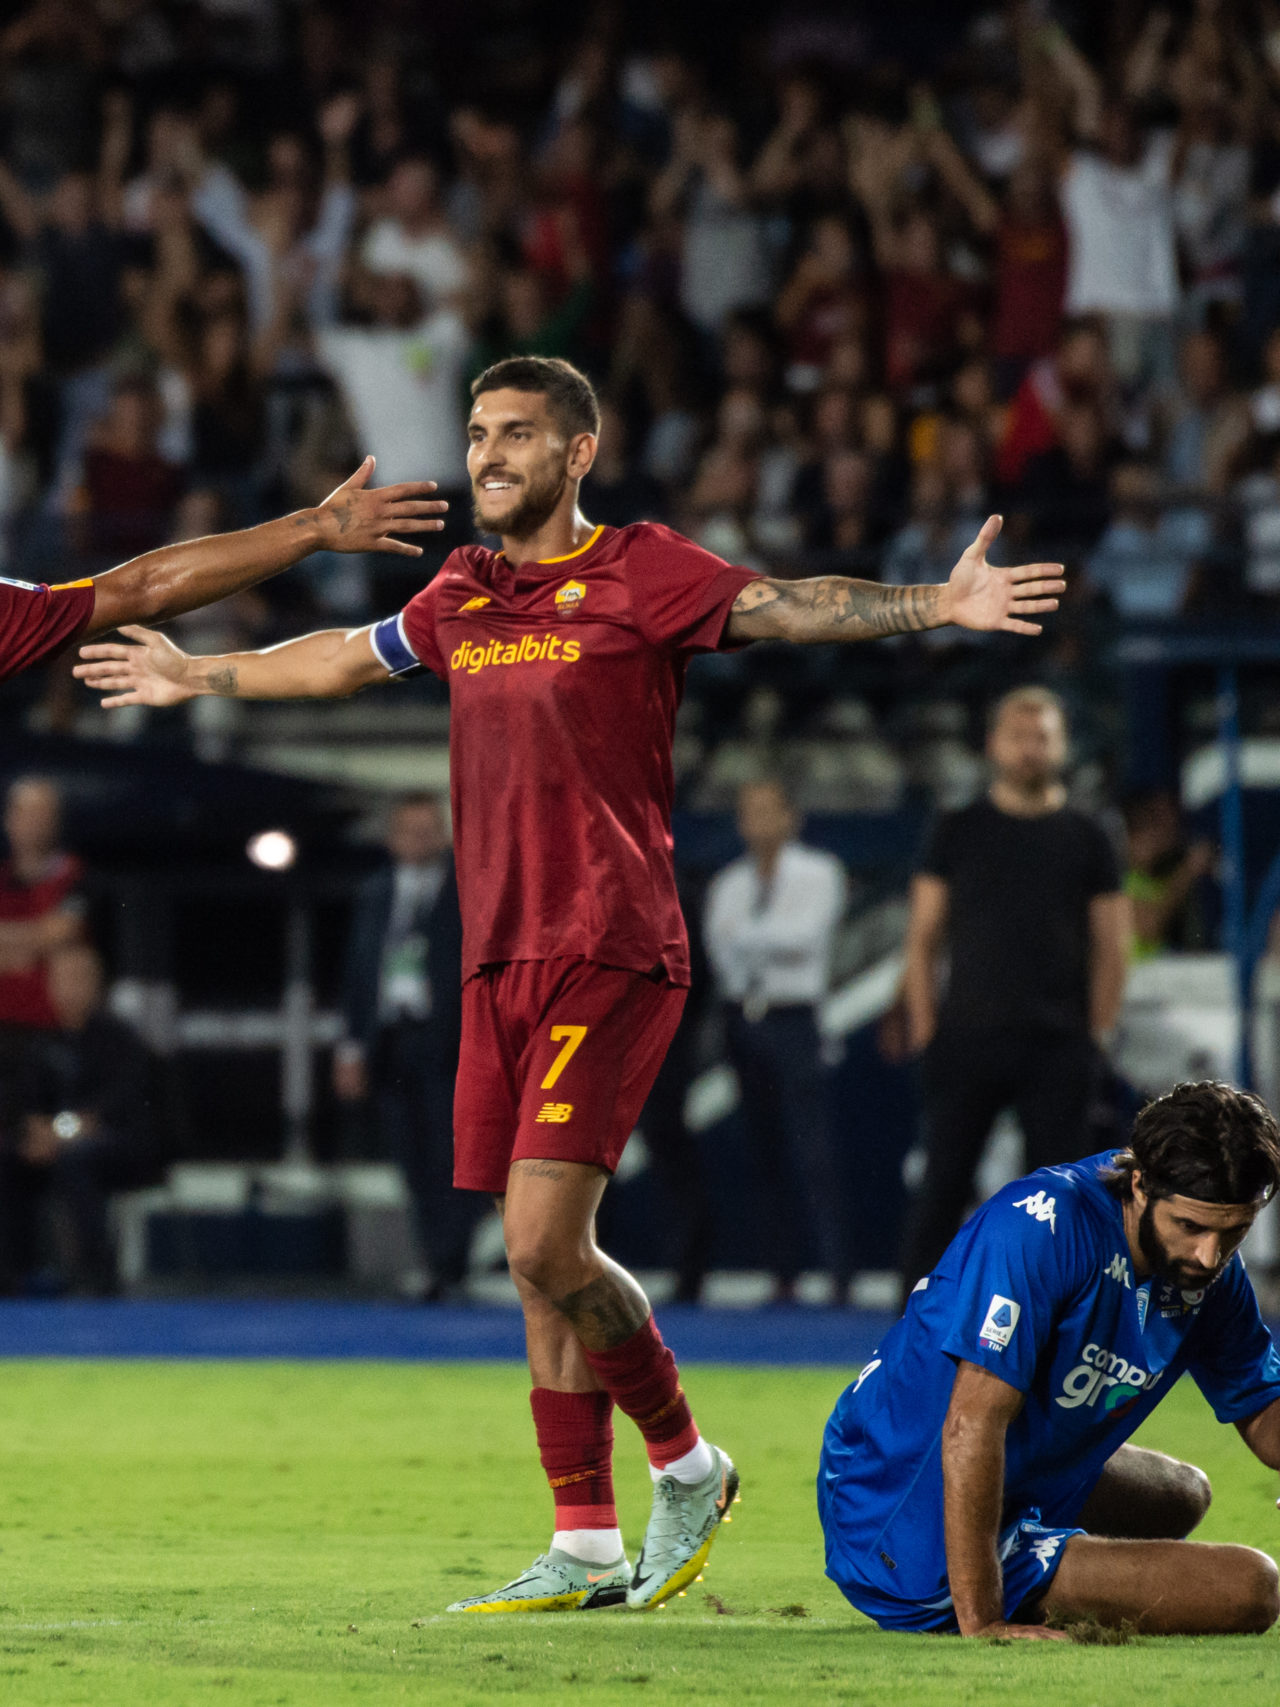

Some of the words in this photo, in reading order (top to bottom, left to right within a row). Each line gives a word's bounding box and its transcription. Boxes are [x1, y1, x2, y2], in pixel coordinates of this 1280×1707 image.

[451, 633, 581, 674] digitalbits
[540, 1025, 588, 1089] 7
[988, 1340, 1003, 1352] TIM
